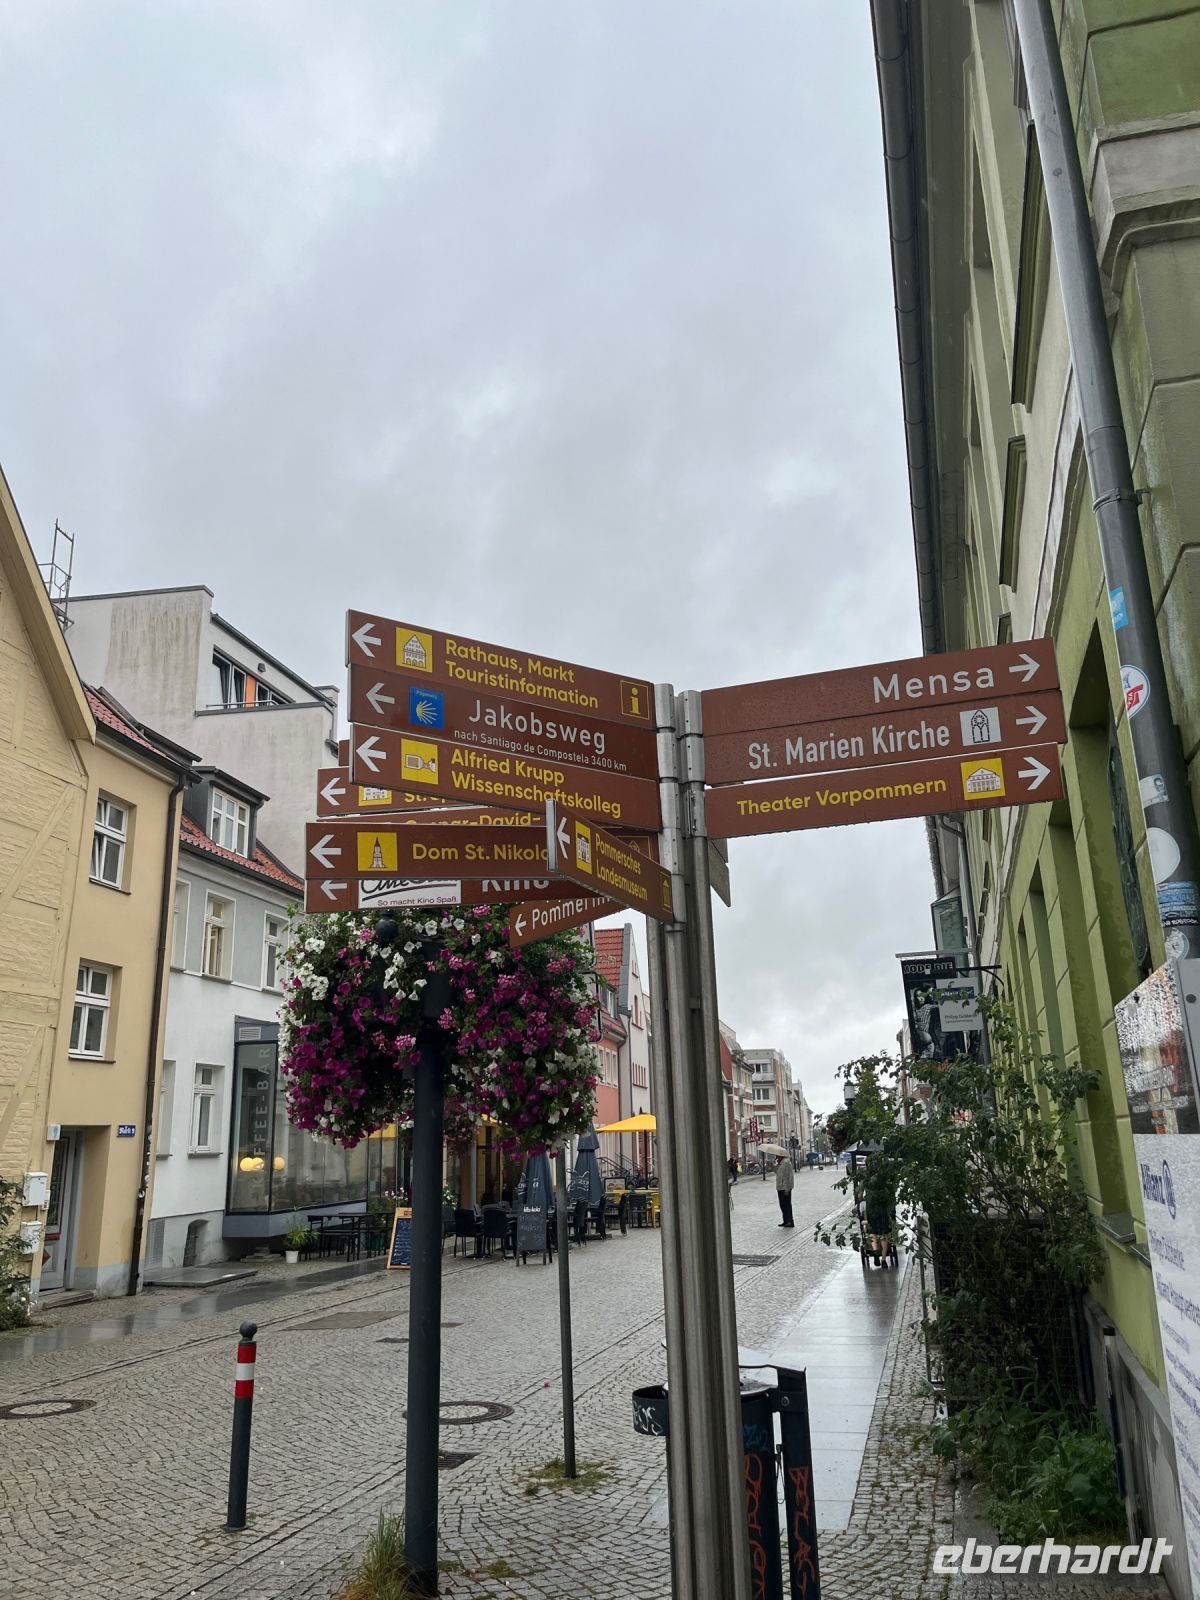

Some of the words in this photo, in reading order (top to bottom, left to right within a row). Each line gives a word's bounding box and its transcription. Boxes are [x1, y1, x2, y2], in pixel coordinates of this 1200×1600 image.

[445, 638, 523, 674] Rathaus,
[527, 658, 575, 684] Markt
[445, 660, 599, 709] Touristinformation
[872, 666, 994, 704] Mensa
[468, 699, 606, 755] Jakobsweg
[748, 742, 777, 770] St.
[785, 733, 864, 765] Marien
[872, 720, 950, 755] Kirche
[451, 748, 510, 774] Alfried
[515, 760, 565, 786] Krupp
[454, 729, 478, 742] nach
[480, 732, 522, 752] Santiago
[523, 742, 535, 754] de
[537, 744, 589, 764] Compostela
[591, 755, 612, 769] 3400
[613, 760, 627, 772] km
[451, 771, 621, 818] Wissenschaftskolleg
[737, 795, 811, 816] Theater
[816, 779, 947, 806] Vorpommern
[412, 843, 459, 860] Dom
[465, 843, 490, 860] St.
[595, 832, 641, 875] Pommersches
[596, 858, 648, 901] Landesmuseum
[377, 899, 388, 907] So
[390, 898, 415, 906] macht
